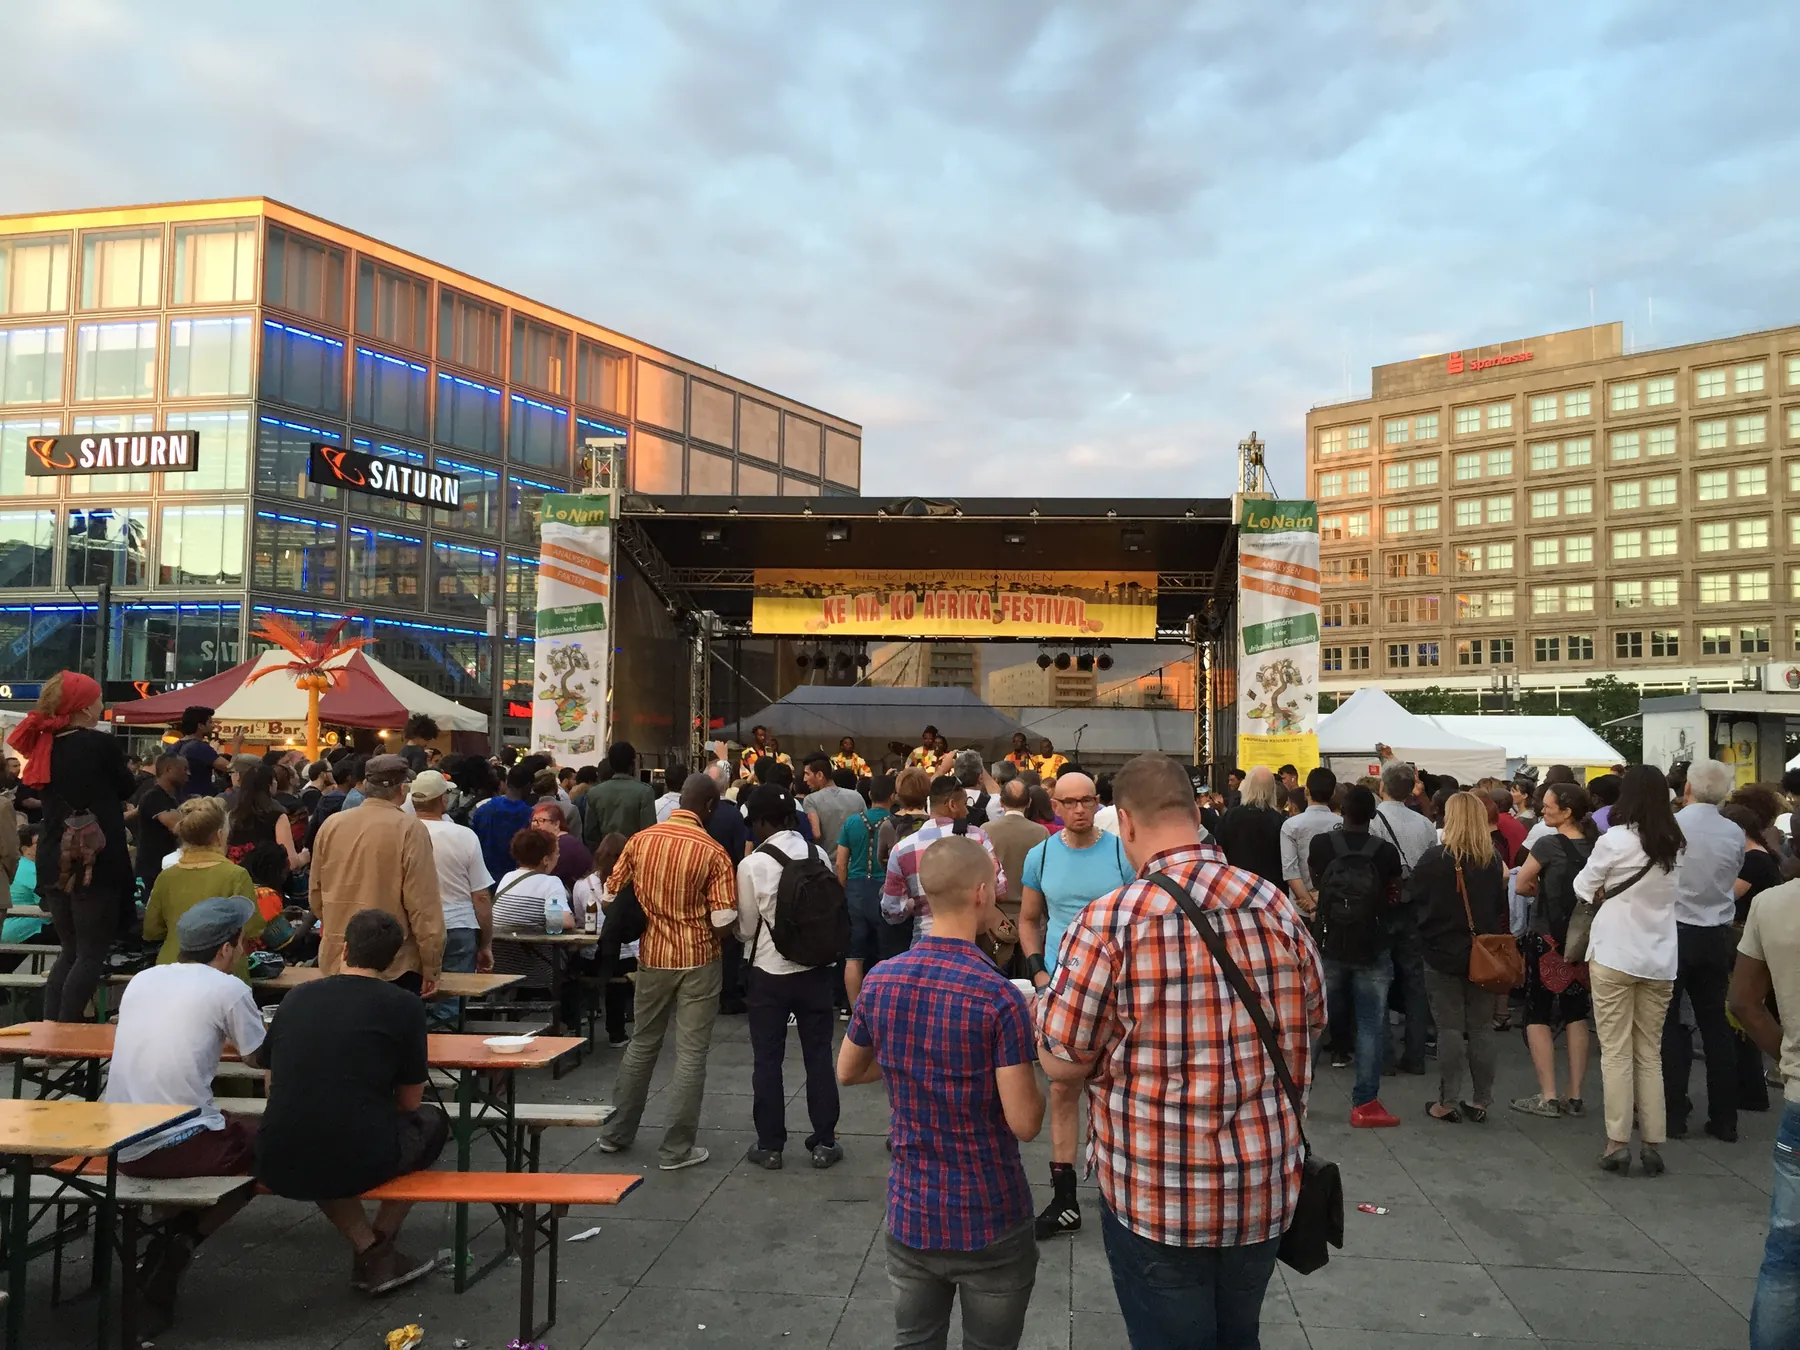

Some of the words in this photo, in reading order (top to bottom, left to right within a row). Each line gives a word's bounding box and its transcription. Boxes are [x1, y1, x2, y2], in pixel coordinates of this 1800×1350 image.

[1469, 351, 1533, 371] Sparkasse
[80, 435, 188, 468] SATURN
[370, 460, 459, 505] SATURN
[544, 504, 605, 523] LoNam
[1247, 512, 1313, 529] LoNam
[553, 549, 591, 567] ANALYSEN
[855, 570, 936, 581] HERZLICH
[940, 571, 1054, 582] WILLKOMMEN
[1260, 560, 1301, 576] ANALYSEN
[557, 570, 586, 586] FAKTEN
[1266, 583, 1296, 597] FAKTEN
[823, 597, 847, 625] KE
[855, 596, 882, 623] NA
[890, 594, 915, 621] KO
[924, 594, 991, 620] AFRIKA
[1000, 595, 1087, 627] FESTIVAL
[1284, 634, 1317, 646] Community
[267, 721, 301, 735] Bar
